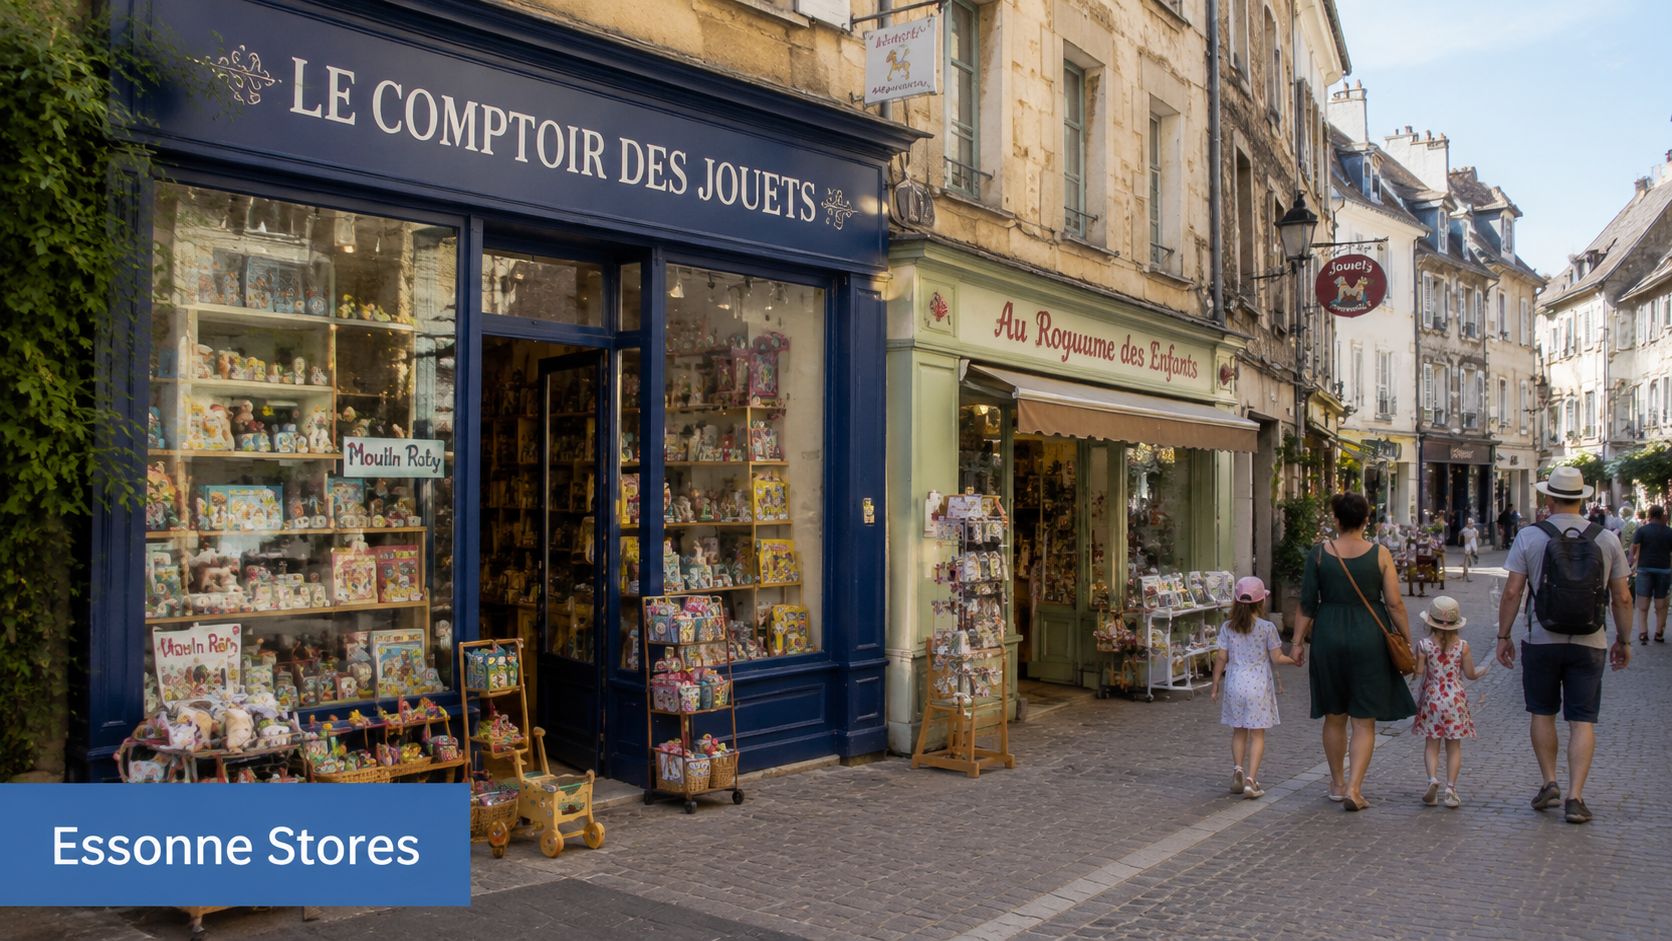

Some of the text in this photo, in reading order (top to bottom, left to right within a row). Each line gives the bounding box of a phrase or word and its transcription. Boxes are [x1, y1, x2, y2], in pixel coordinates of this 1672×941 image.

[290, 56, 816, 222] LE COMPTOIR DES JOUETS
[994, 301, 1027, 342] Au
[1120, 334, 1144, 367] des
[1149, 340, 1198, 382] Enfants
[405, 444, 441, 474] Roty
